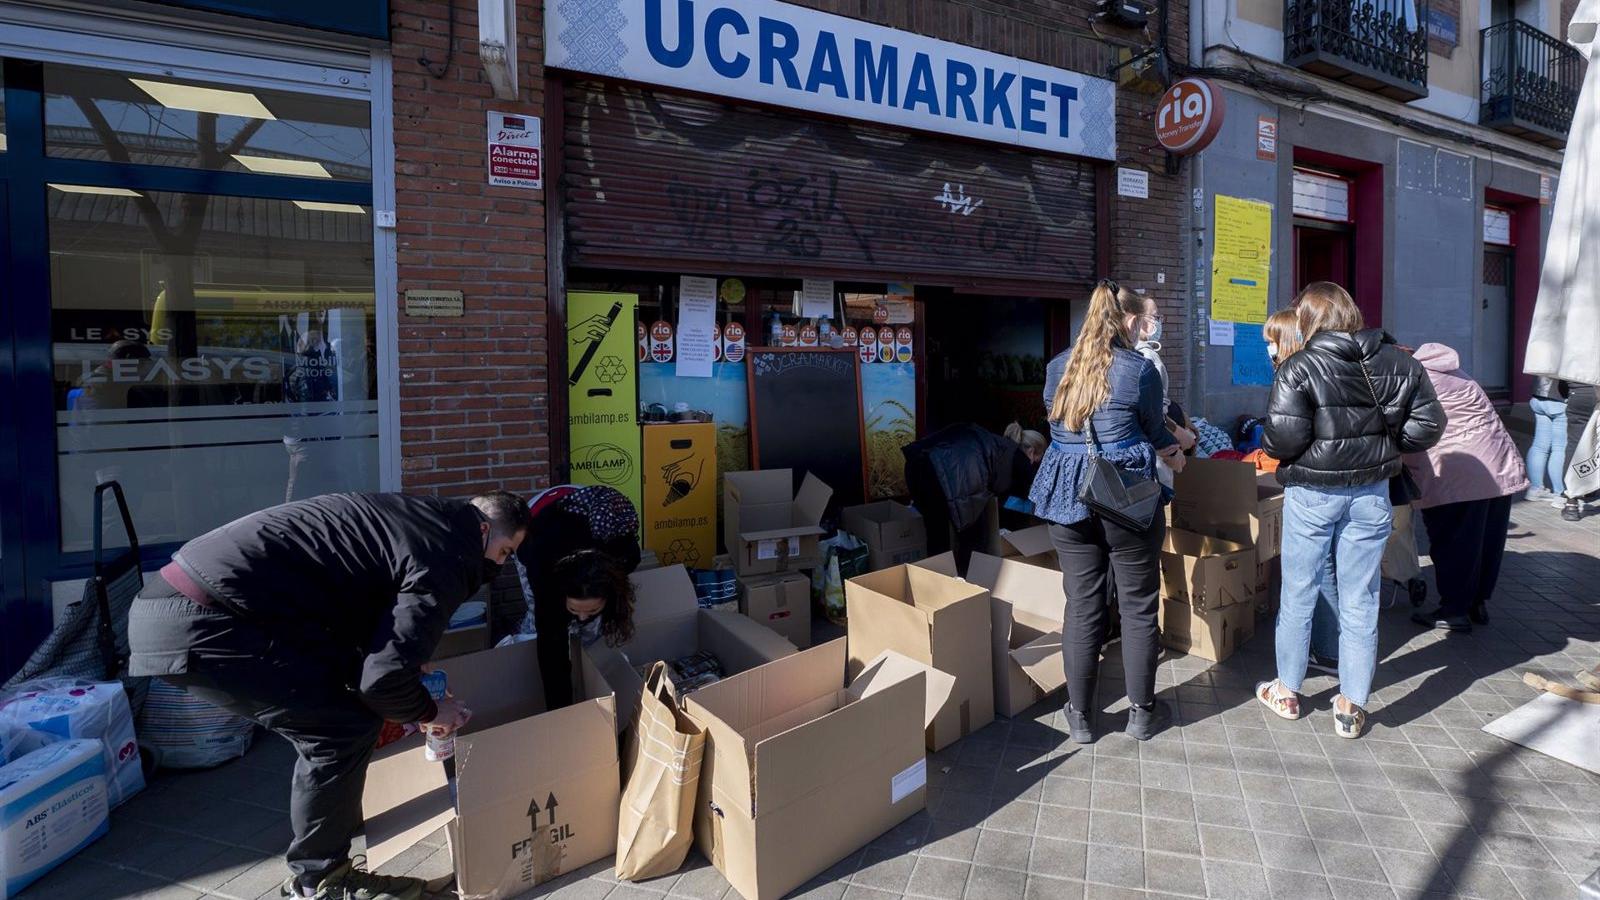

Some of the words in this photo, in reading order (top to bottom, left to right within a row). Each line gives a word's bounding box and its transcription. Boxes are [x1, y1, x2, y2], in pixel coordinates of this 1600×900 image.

[645, 0, 1078, 138] UCRAMARKET
[1159, 87, 1202, 128] ria
[1159, 128, 1178, 139] Money
[492, 146, 538, 159] Alarma
[492, 155, 538, 166] conectada
[493, 177, 511, 185] Aviso
[653, 323, 670, 335] ria
[726, 324, 743, 336] ria
[802, 328, 816, 338] ria
[842, 328, 856, 338] ria
[861, 330, 875, 339] ria
[879, 329, 893, 339] ria
[898, 330, 911, 340] ria
[81, 356, 272, 384] LEASYS
[296, 366, 334, 378] Store
[569, 412, 629, 425] ambilamp.es
[570, 458, 626, 471] AMBILAMP
[654, 515, 708, 530] ambilamp.es
[511, 823, 575, 860] FGIL
